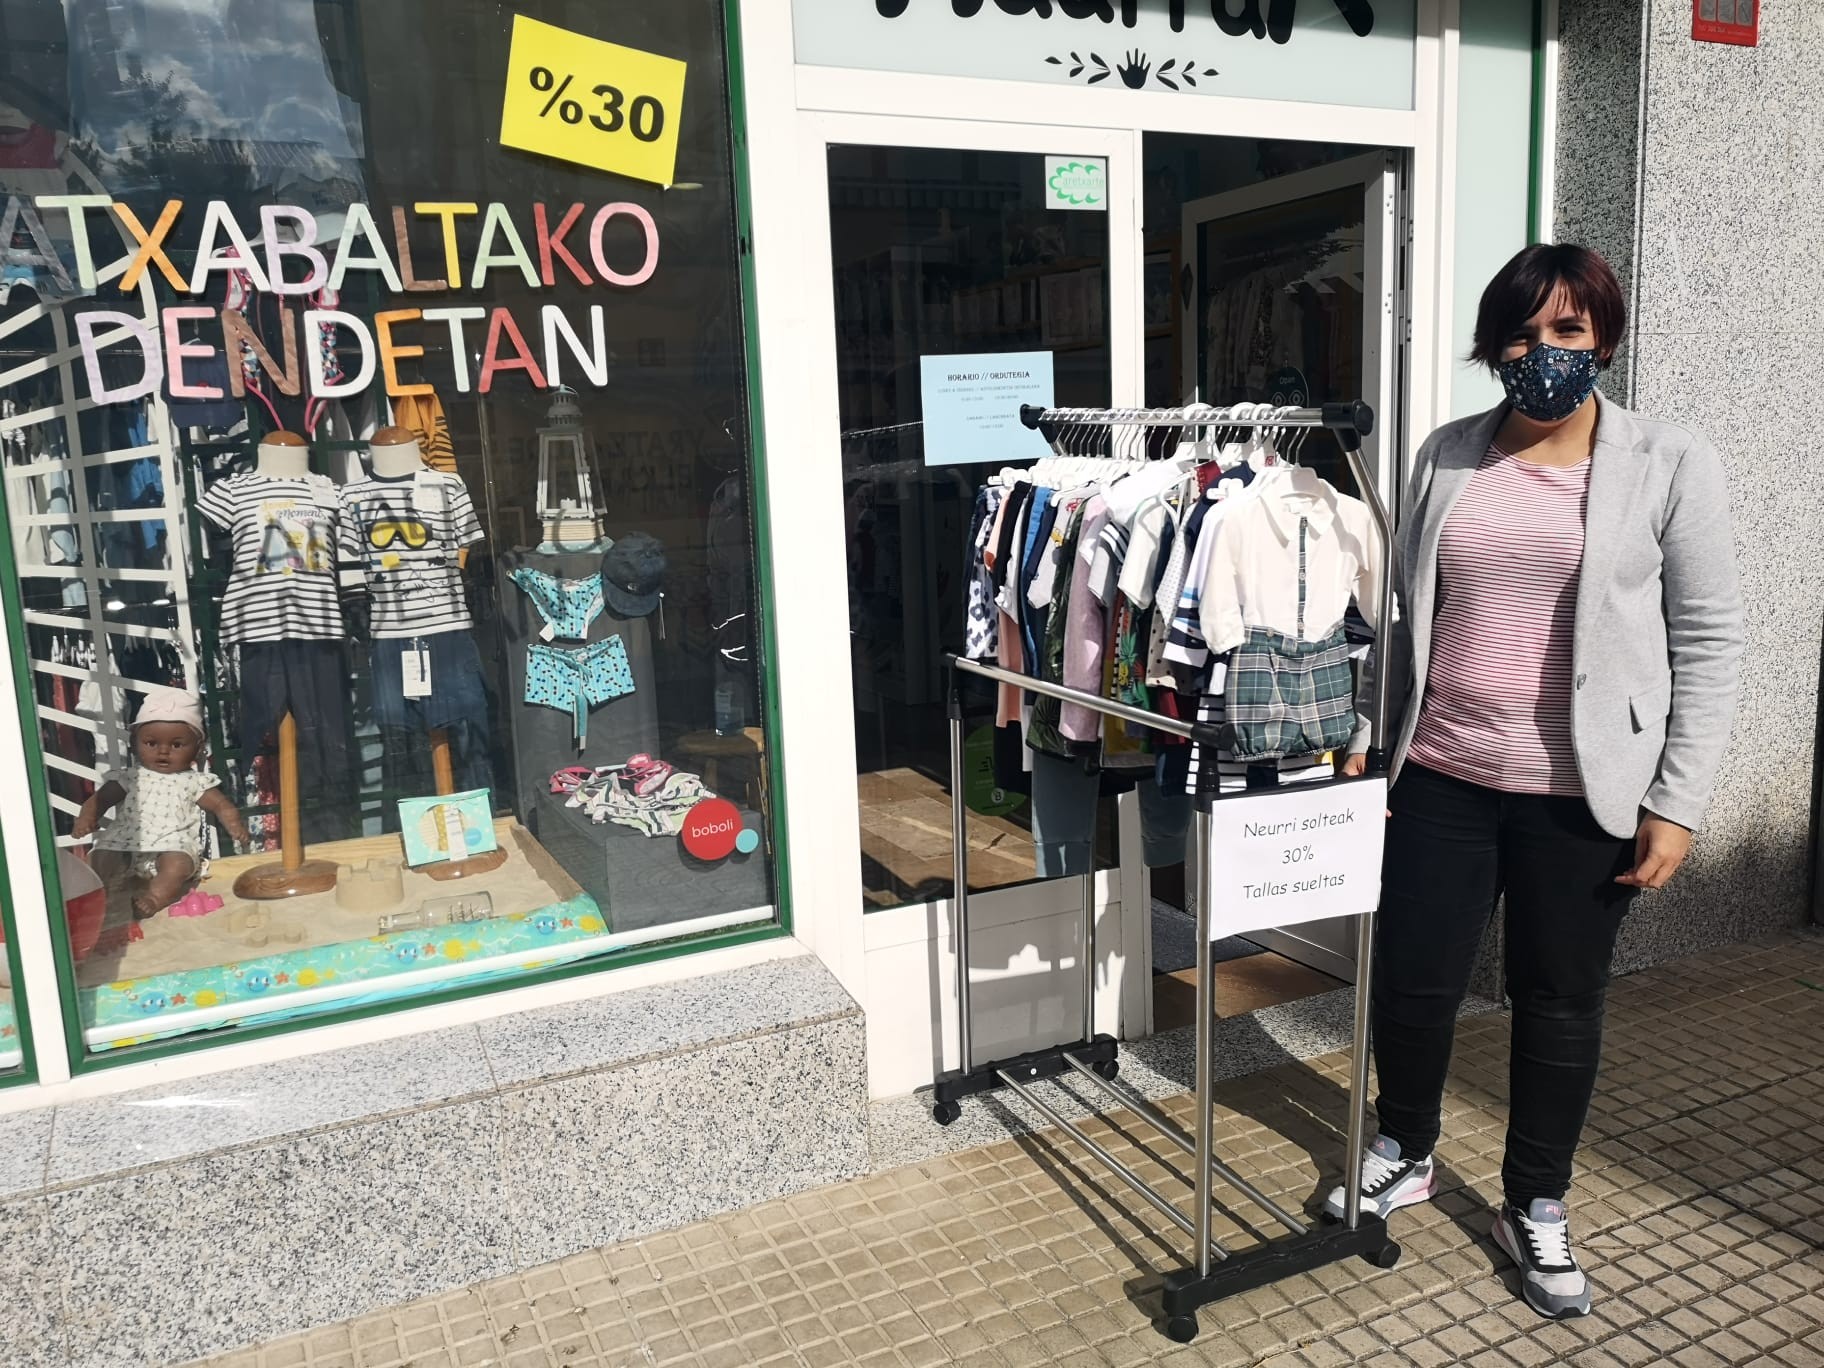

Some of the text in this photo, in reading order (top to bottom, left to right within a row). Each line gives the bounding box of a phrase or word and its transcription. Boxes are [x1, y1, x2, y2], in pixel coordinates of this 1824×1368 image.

[529, 66, 665, 143] %30
[0, 195, 660, 295] ATXABALTAKO
[75, 305, 609, 404] DENDETAN
[947, 373, 980, 381] HORARIO
[990, 371, 1030, 380] ORDUTEGIA
[692, 818, 733, 838] boboli
[1243, 808, 1355, 839] Neurri solteak
[1282, 844, 1314, 864] 30%
[1243, 873, 1345, 899] Tallas sueltas
